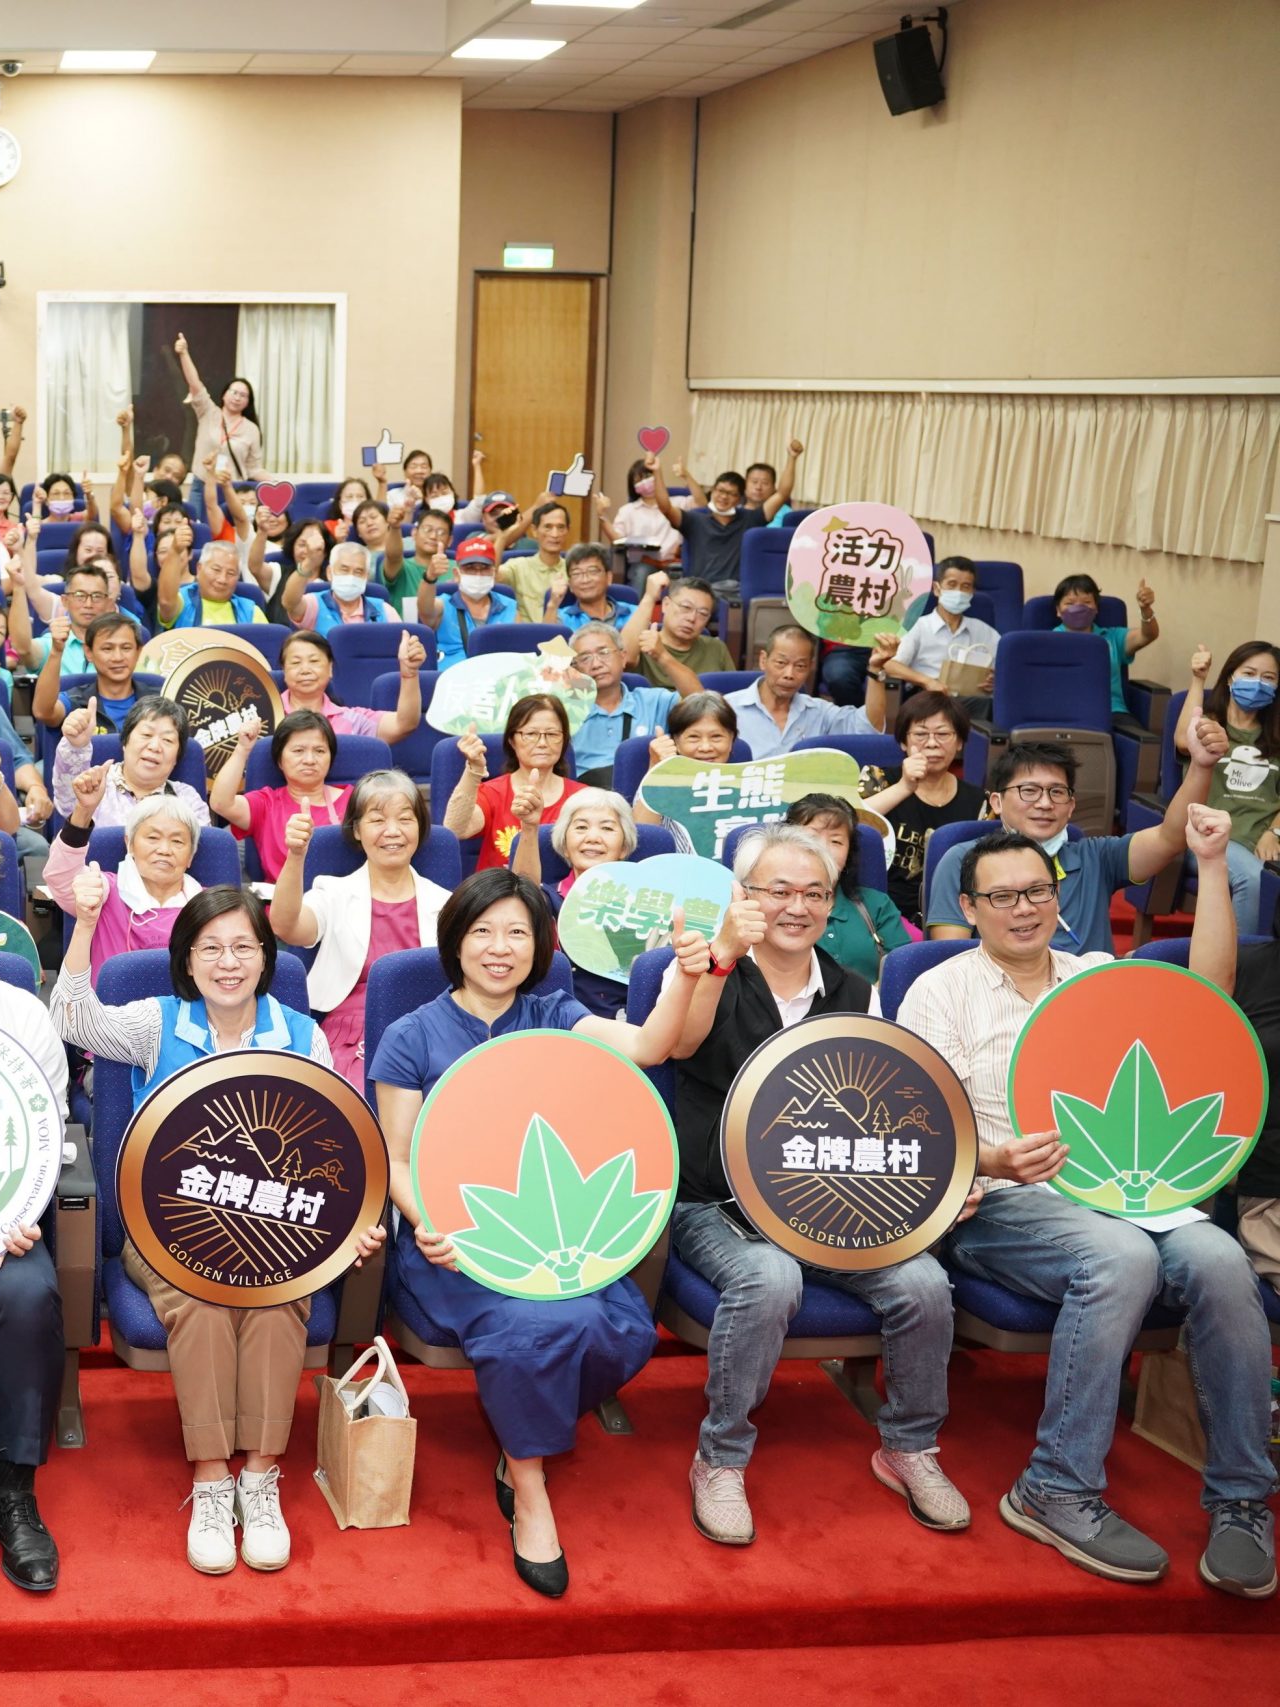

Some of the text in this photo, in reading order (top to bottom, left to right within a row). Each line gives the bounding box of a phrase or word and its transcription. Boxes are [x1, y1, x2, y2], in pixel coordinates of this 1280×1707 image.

[831, 534, 896, 569] 活力
[824, 574, 891, 611] 農村
[690, 763, 786, 813] 生態
[1230, 777, 1253, 788] Olive
[38, 1117, 51, 1152] MOA
[781, 1134, 921, 1174] 金牌農村
[176, 1164, 326, 1225] 金牌農村
[789, 1216, 913, 1248] GOLDEN VILLAGE
[168, 1243, 293, 1286] GOLDEN VILLAGE
